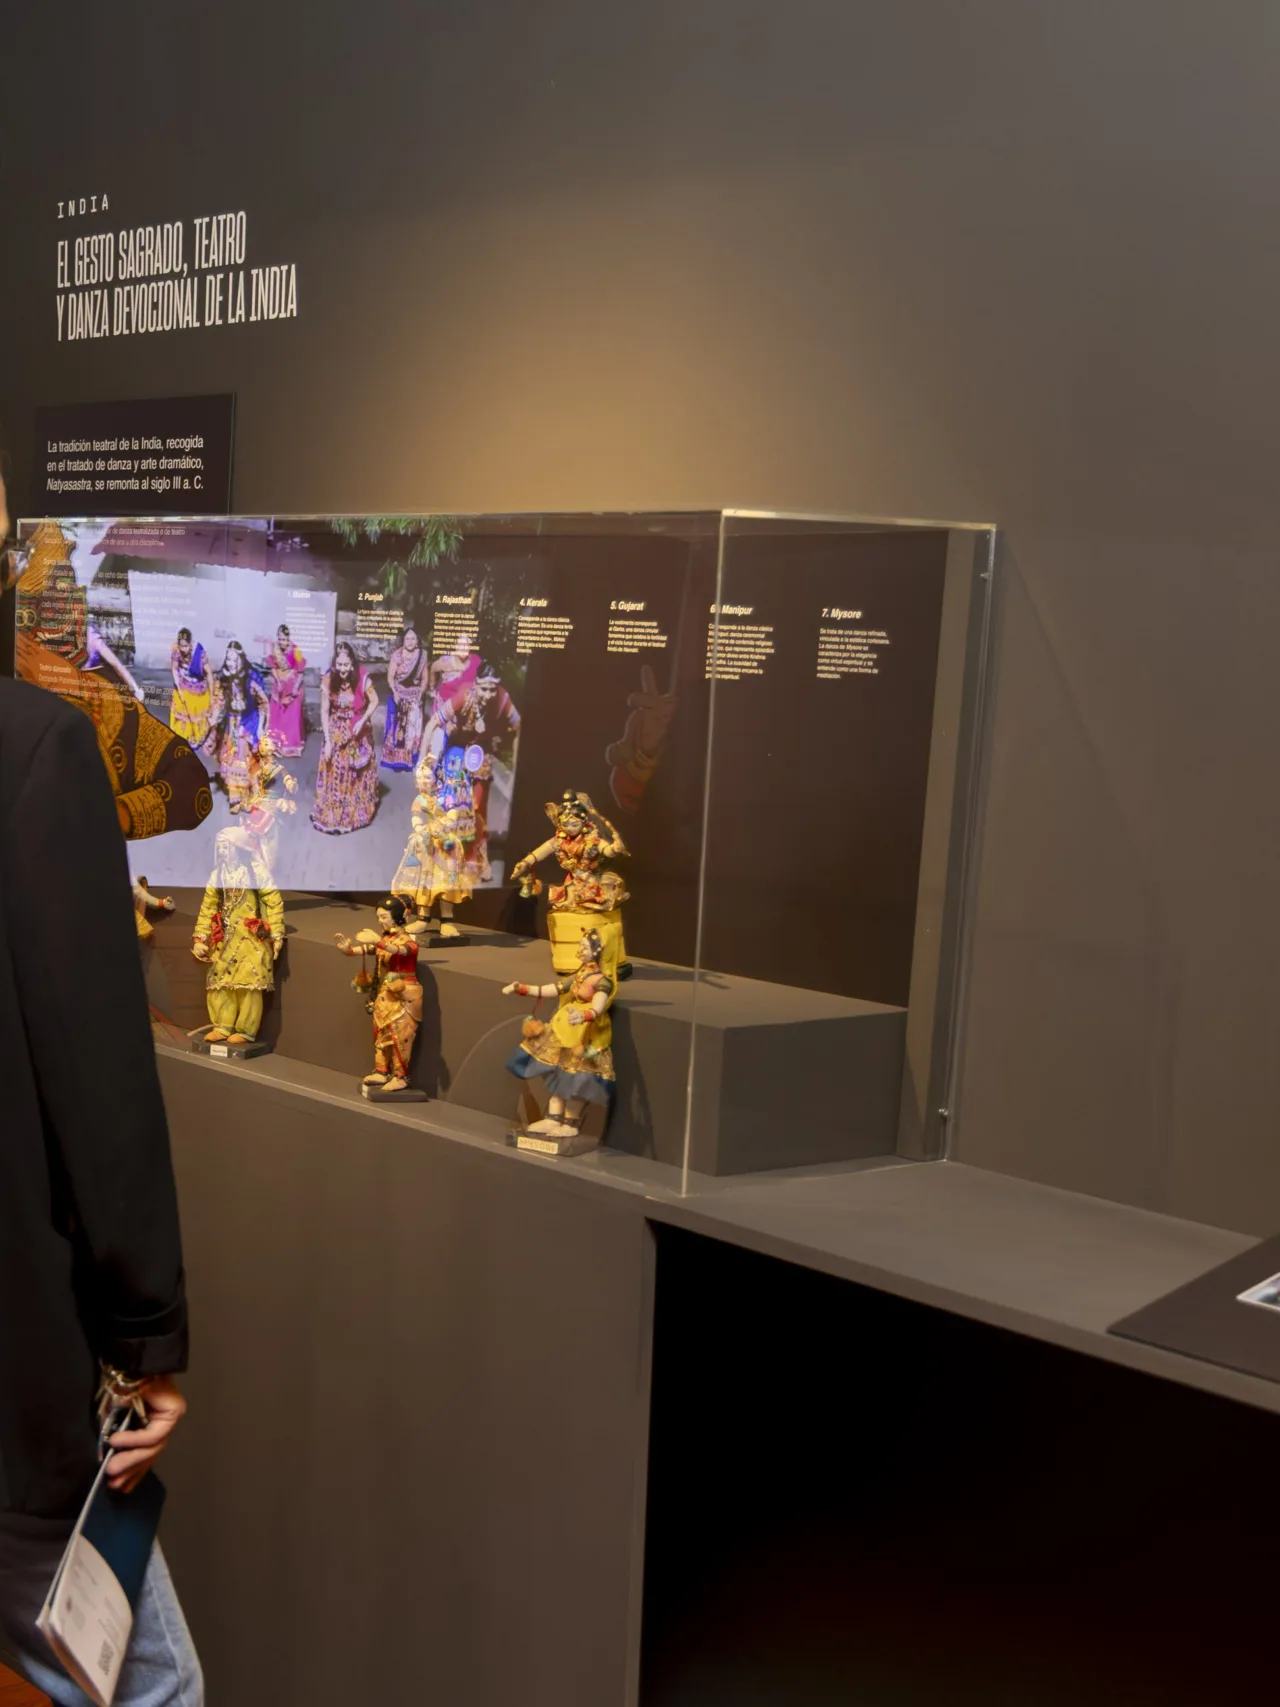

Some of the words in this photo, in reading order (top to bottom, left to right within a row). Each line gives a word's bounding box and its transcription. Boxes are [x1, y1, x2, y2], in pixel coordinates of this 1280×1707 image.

[57, 194, 109, 219] INDIA
[57, 240, 71, 288] EL
[74, 232, 115, 286] GESTO
[119, 221, 189, 278] SAGRADO,
[194, 211, 247, 269] TEATRO
[56, 295, 65, 341] Y
[68, 289, 109, 340] DANZA
[113, 277, 200, 336] DEVOCIONAL
[205, 273, 224, 326] DE
[228, 271, 246, 324] LA
[249, 263, 297, 321] INDIA
[48, 440, 57, 452] La
[59, 440, 90, 452] tradición
[93, 438, 117, 451] teatral
[119, 438, 129, 450] de
[132, 437, 139, 450] la
[141, 436, 163, 451] India,
[166, 435, 203, 451] recogida
[47, 462, 56, 471] en
[58, 460, 65, 471] el
[67, 459, 93, 471] tratado
[95, 458, 105, 471] de
[107, 458, 131, 470] danza
[134, 459, 138, 473] y
[141, 458, 157, 470] arte
[159, 455, 203, 470] dramático,
[47, 479, 92, 493] Natyasastra,
[95, 481, 104, 490] se
[107, 478, 139, 489] remonta
[141, 477, 148, 489] al
[151, 476, 170, 492] siglo
[183, 479, 191, 488] a.
[194, 475, 203, 489] C.
[618, 601, 644, 612] Gujarat
[710, 604, 718, 613] 6
[722, 605, 753, 616] Manipur
[822, 608, 828, 617] 7.
[831, 608, 861, 620] Mysore
